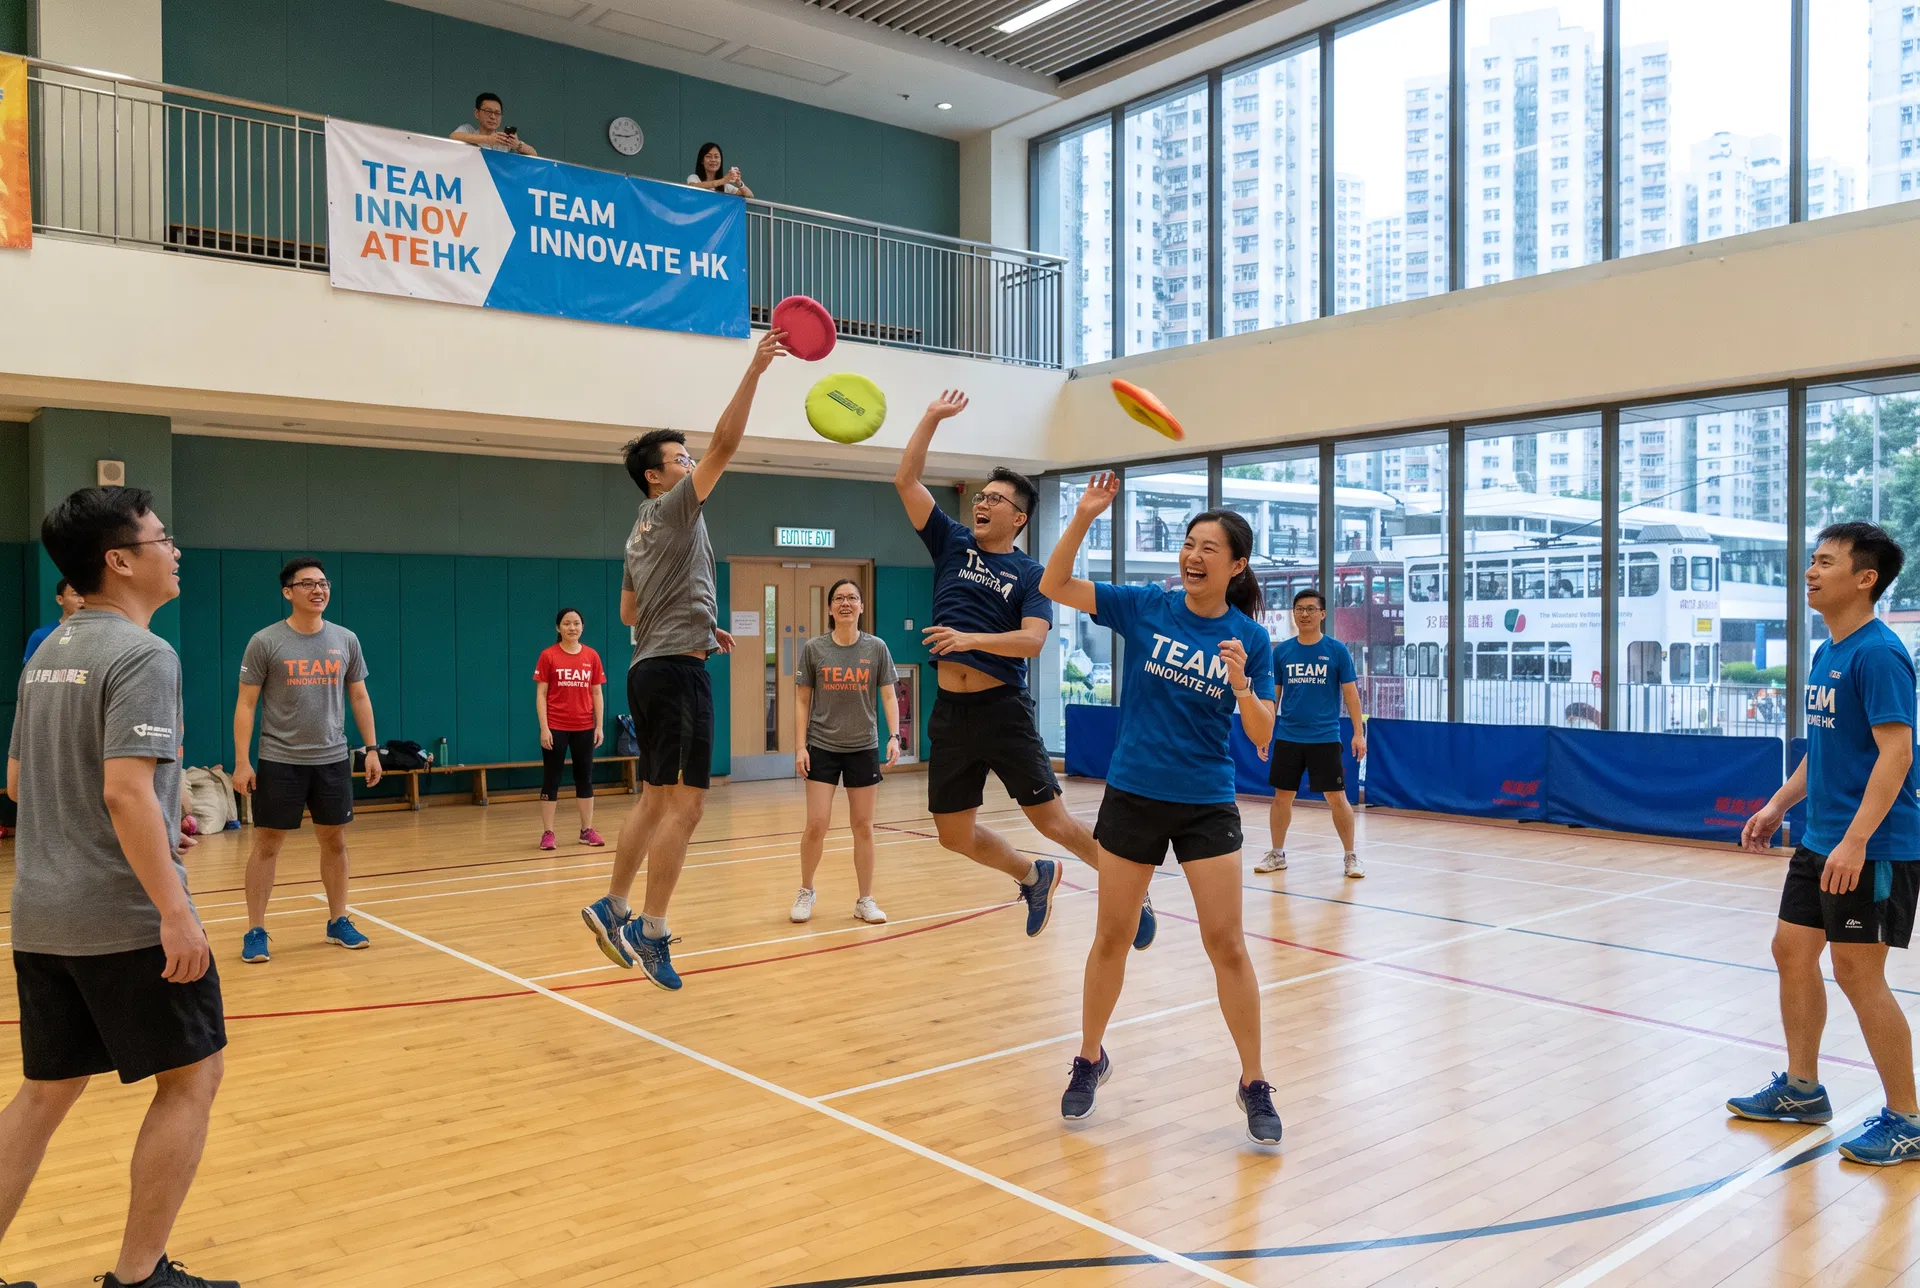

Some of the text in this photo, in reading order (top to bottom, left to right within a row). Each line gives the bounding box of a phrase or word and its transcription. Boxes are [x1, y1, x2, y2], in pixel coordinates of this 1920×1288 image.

[362, 160, 462, 205] TEAM
[355, 193, 468, 238] INNOV
[528, 187, 615, 229] TEAM
[360, 231, 481, 275] ATEHK
[530, 225, 729, 281] INNOVATE HK
[283, 659, 342, 676] TEAM
[556, 668, 591, 682] TEAM
[821, 666, 870, 683] TEAM
[1144, 660, 1225, 700] INNOVATE HK
[1151, 633, 1230, 686] TEAM
[1286, 663, 1328, 677] TEAM
